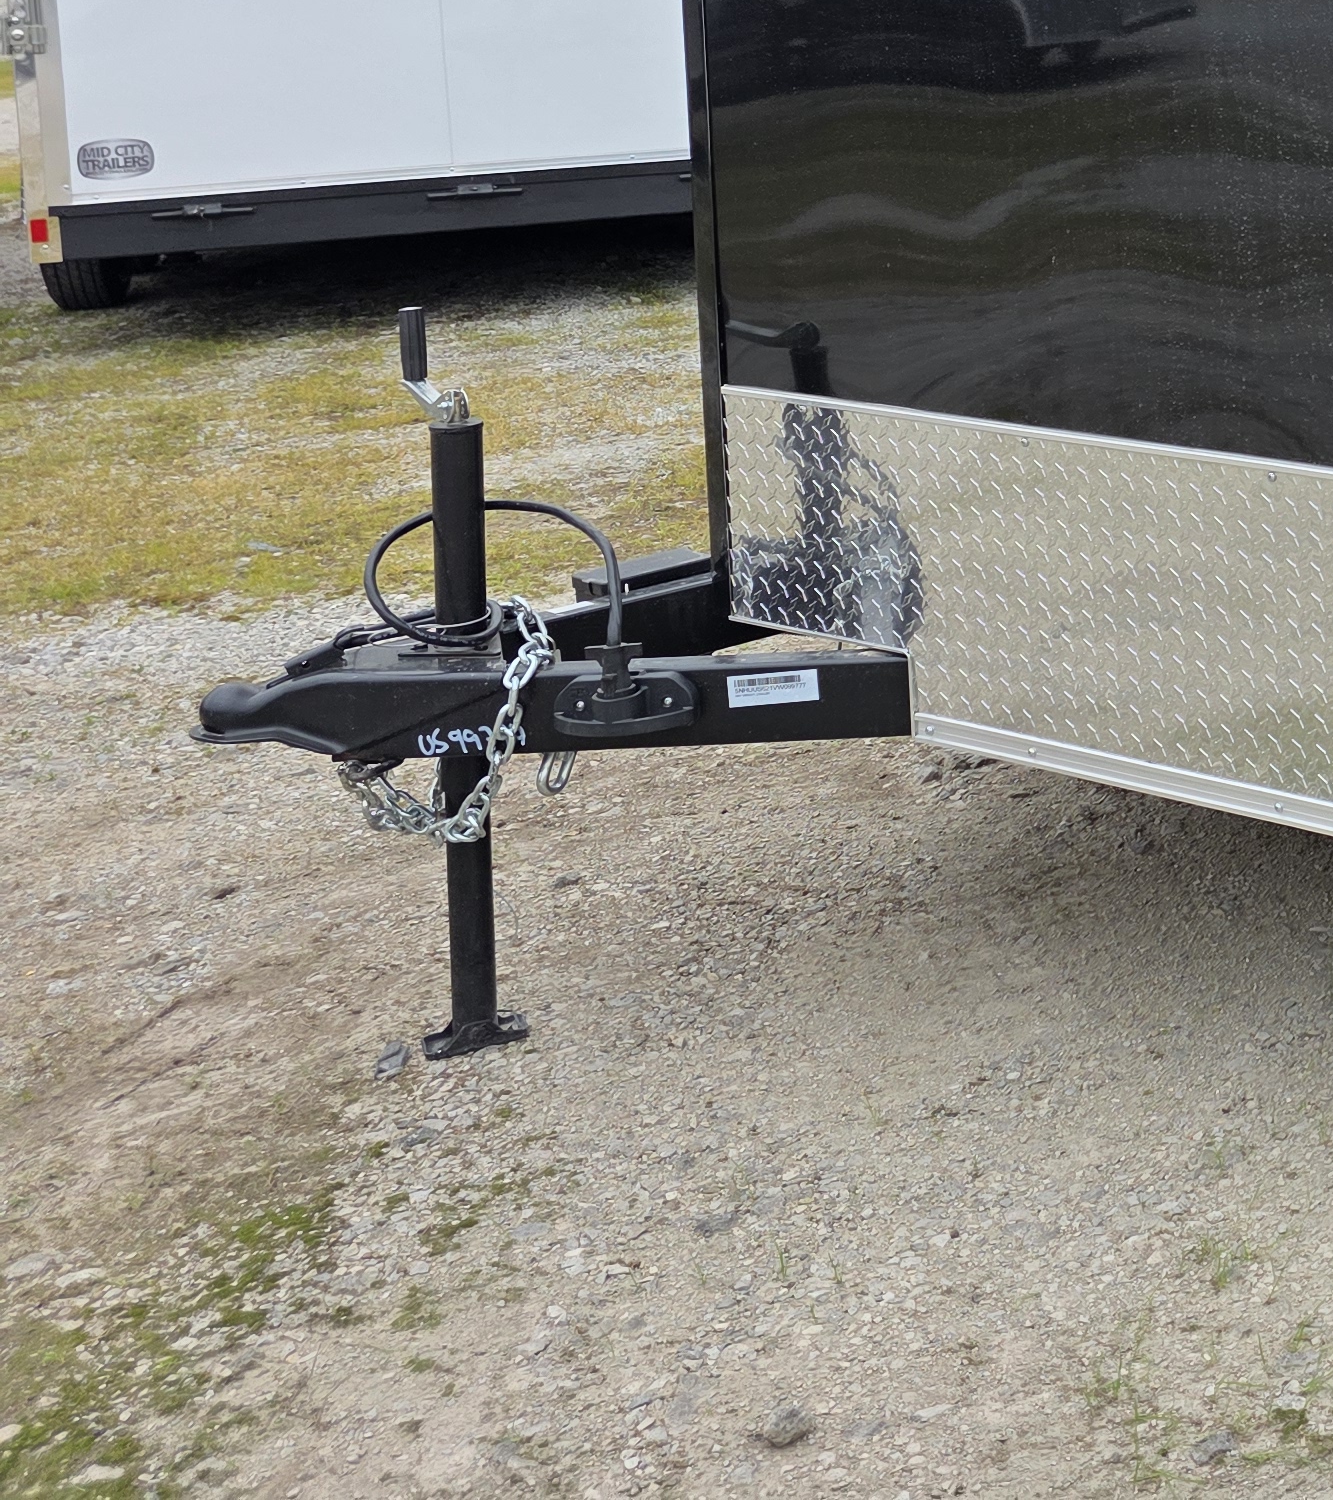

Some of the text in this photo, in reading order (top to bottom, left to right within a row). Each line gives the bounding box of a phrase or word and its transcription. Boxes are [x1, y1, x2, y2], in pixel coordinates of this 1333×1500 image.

[82, 143, 147, 159] MID CITY
[82, 155, 150, 171] TRAILERS
